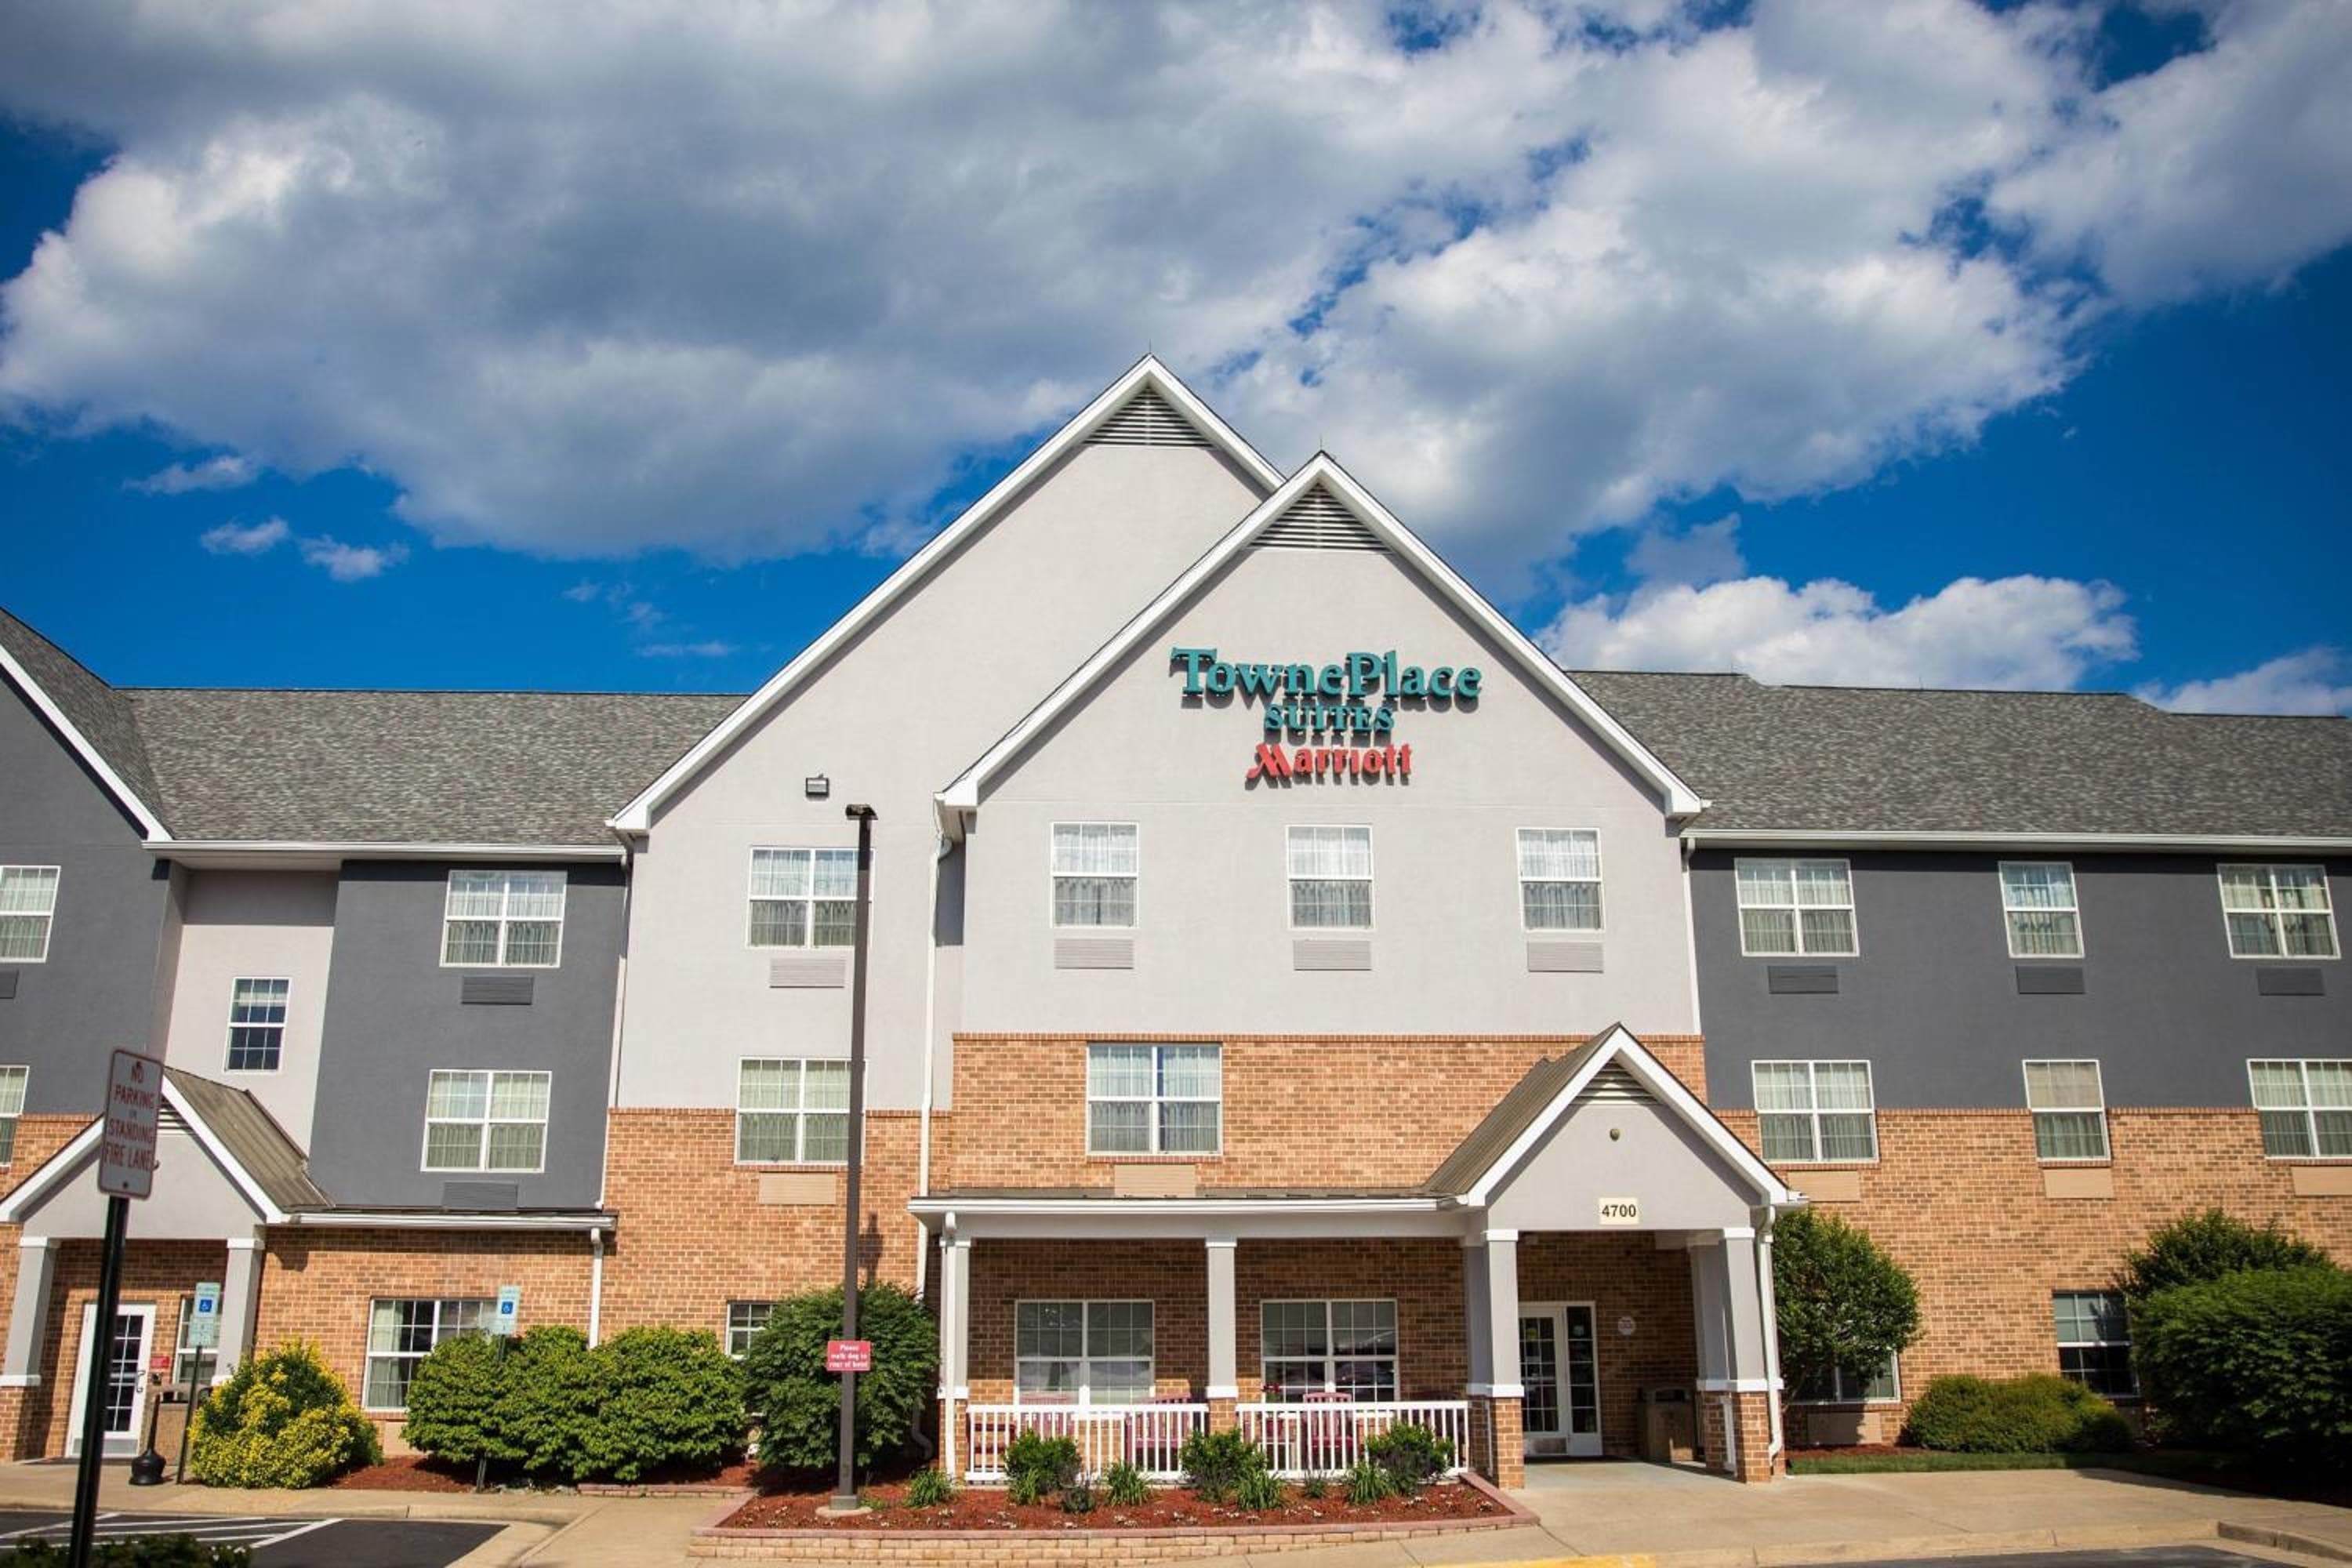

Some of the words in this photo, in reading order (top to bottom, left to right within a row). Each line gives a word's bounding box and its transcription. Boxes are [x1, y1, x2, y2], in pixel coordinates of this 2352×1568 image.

[1171, 647, 1483, 699] TownePlace
[1264, 702, 1395, 731] SUITES
[1246, 742, 1411, 779] Marriott
[130, 1063, 144, 1083] NO
[114, 1084, 154, 1109] PARKING
[107, 1118, 154, 1144] STANDING
[104, 1141, 126, 1167] FIRE
[128, 1147, 154, 1172] LANE
[1602, 1204, 1636, 1218] 4700
